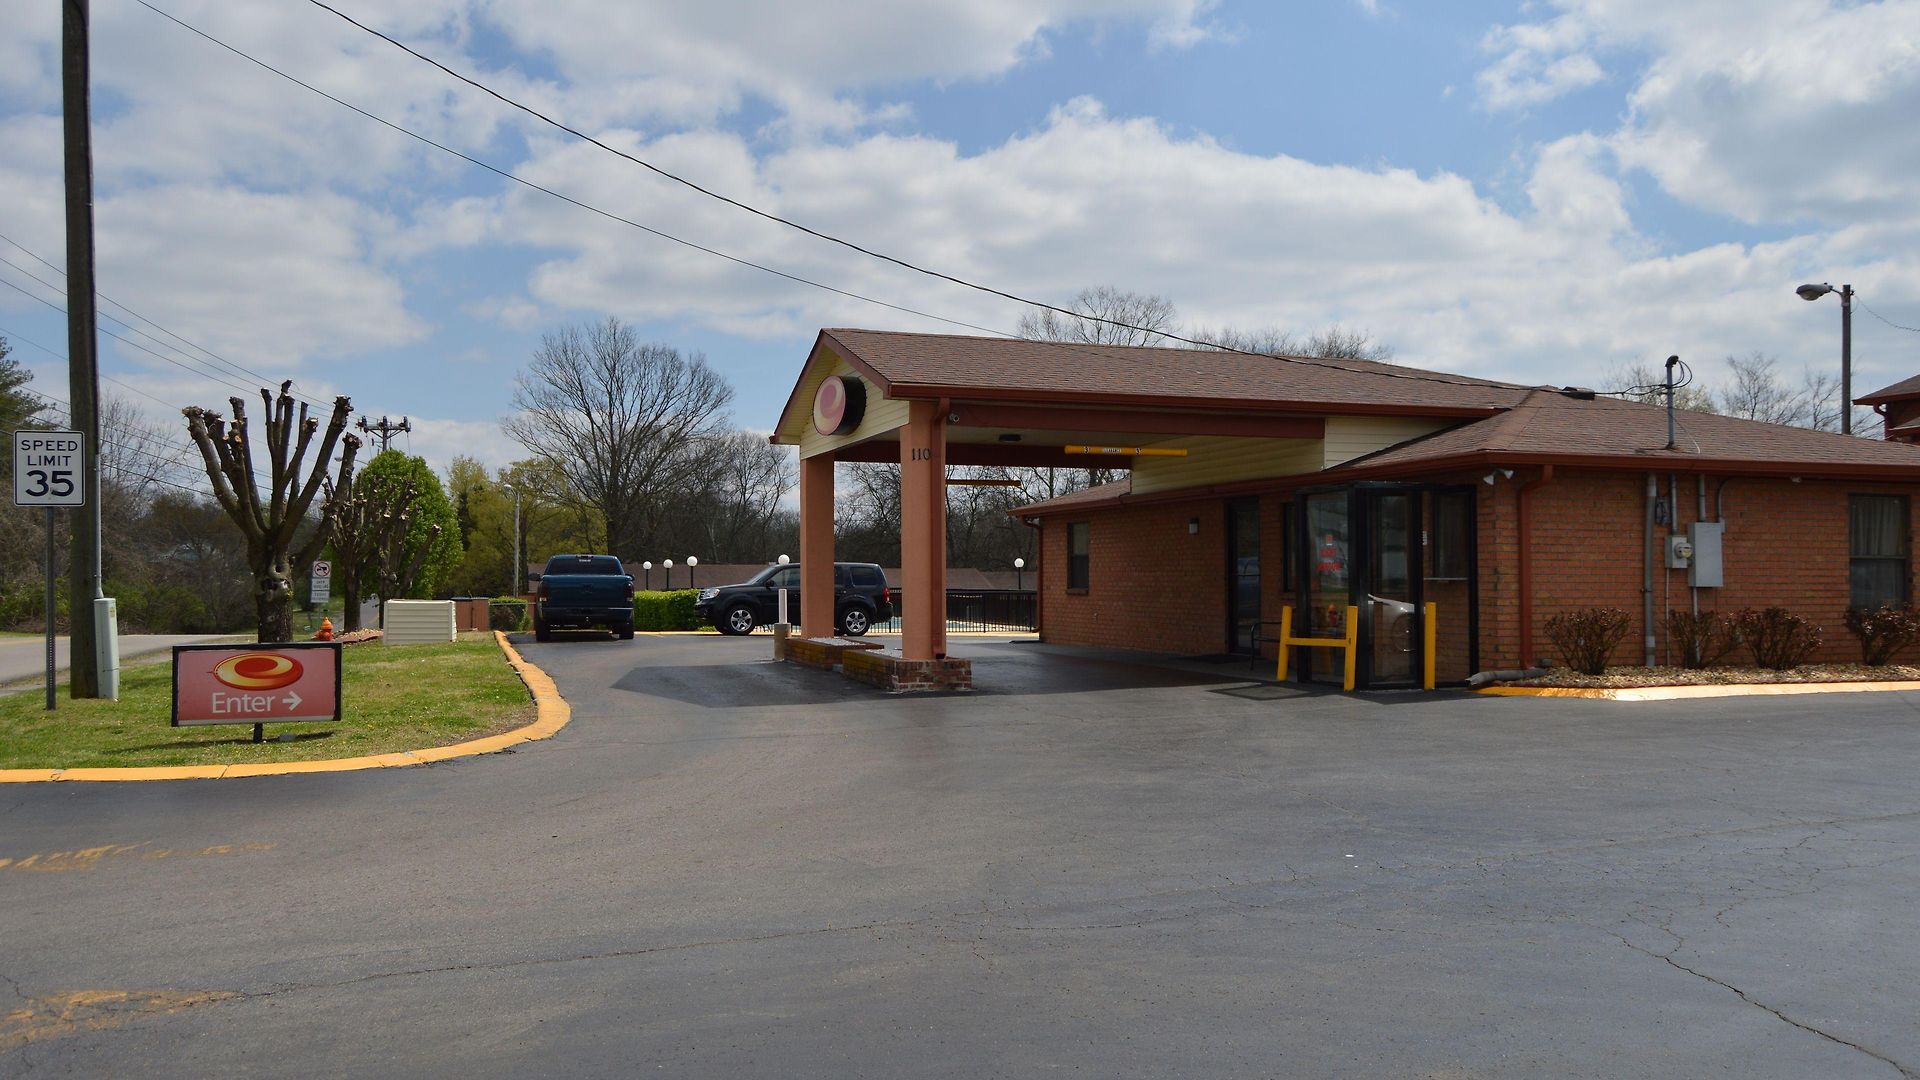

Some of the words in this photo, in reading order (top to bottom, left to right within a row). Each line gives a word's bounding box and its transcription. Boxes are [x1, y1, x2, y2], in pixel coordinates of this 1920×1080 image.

[21, 439, 78, 452] SPEED
[27, 455, 72, 466] LIMIT
[911, 447, 931, 461] 110
[25, 469, 75, 497] 35
[211, 692, 276, 714] Enter
